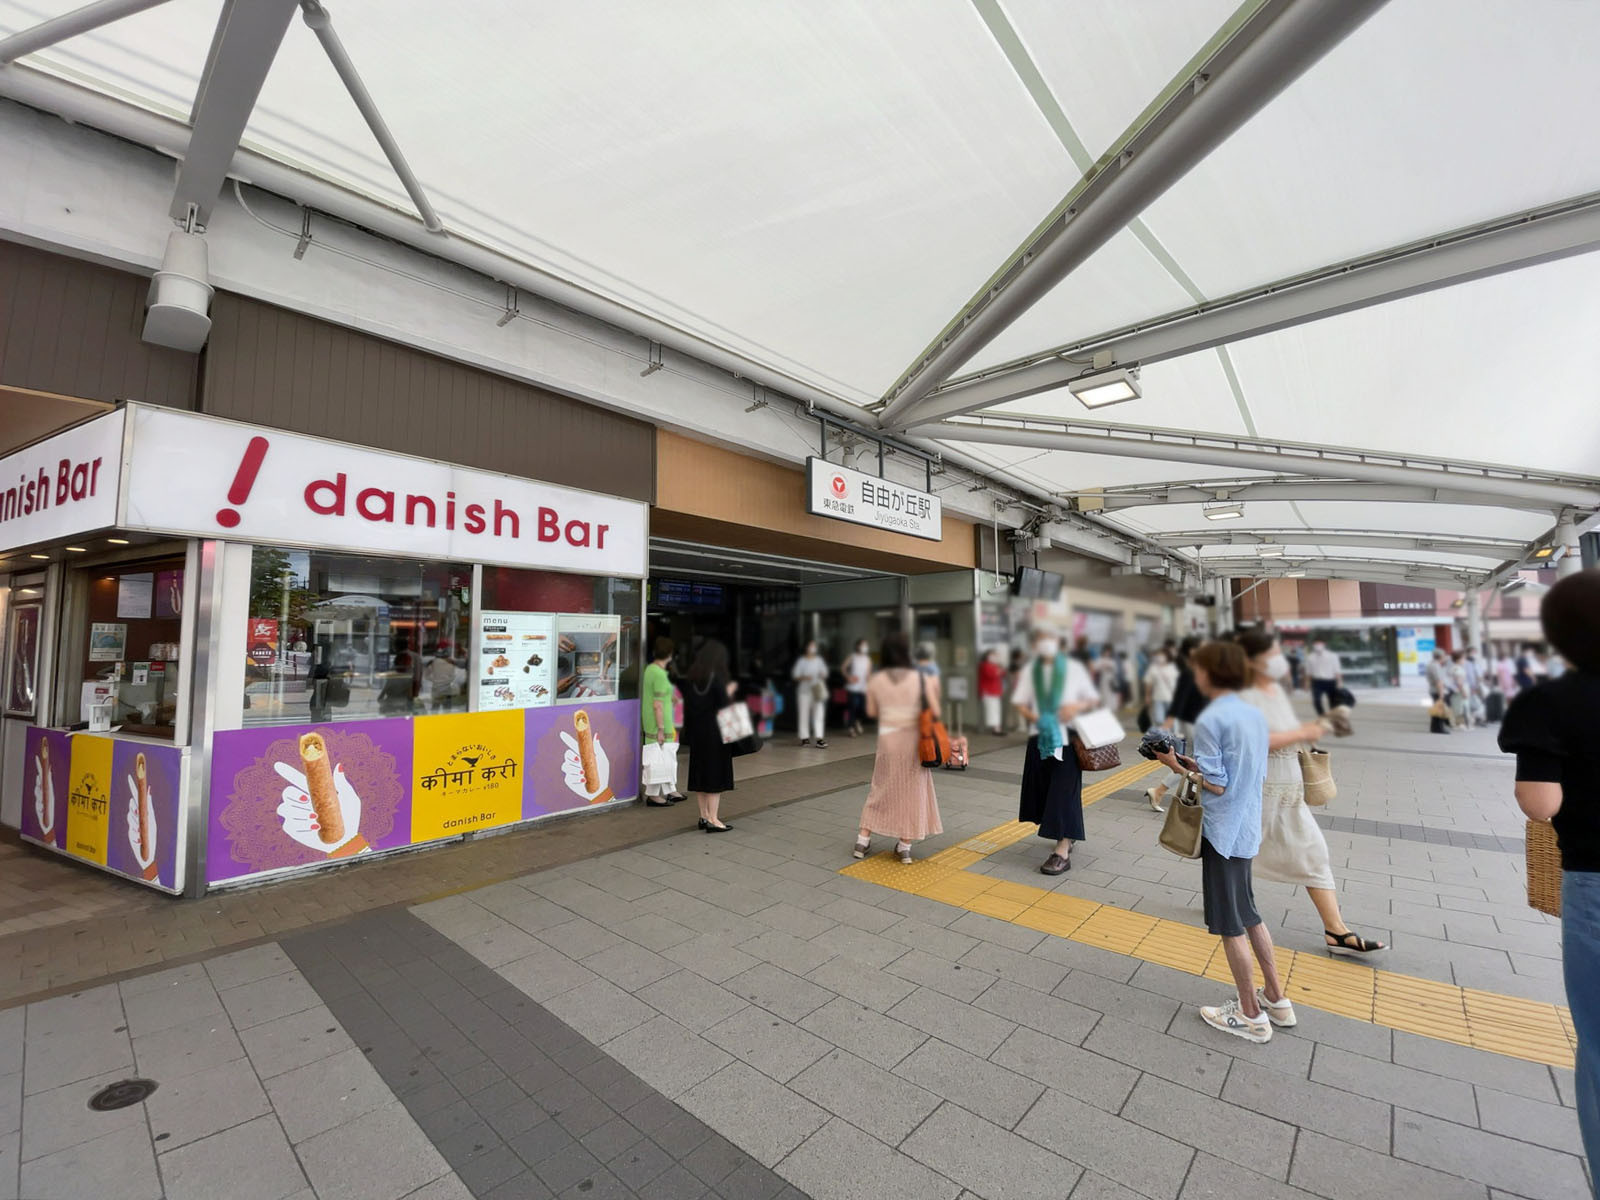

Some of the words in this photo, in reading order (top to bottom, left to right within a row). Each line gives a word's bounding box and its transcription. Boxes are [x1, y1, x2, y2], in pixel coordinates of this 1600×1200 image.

[0, 466, 50, 523] nish
[55, 456, 103, 506] Bar
[862, 481, 931, 519] 自由が丘駅
[303, 472, 520, 539] danish
[536, 505, 609, 550] Bar
[823, 498, 854, 514] 東急電鉄
[875, 511, 908, 527] Jiyugaoka
[421, 767, 474, 790] कीमा
[481, 759, 517, 781] करी
[443, 815, 478, 829] danish
[480, 811, 497, 822] Bar
